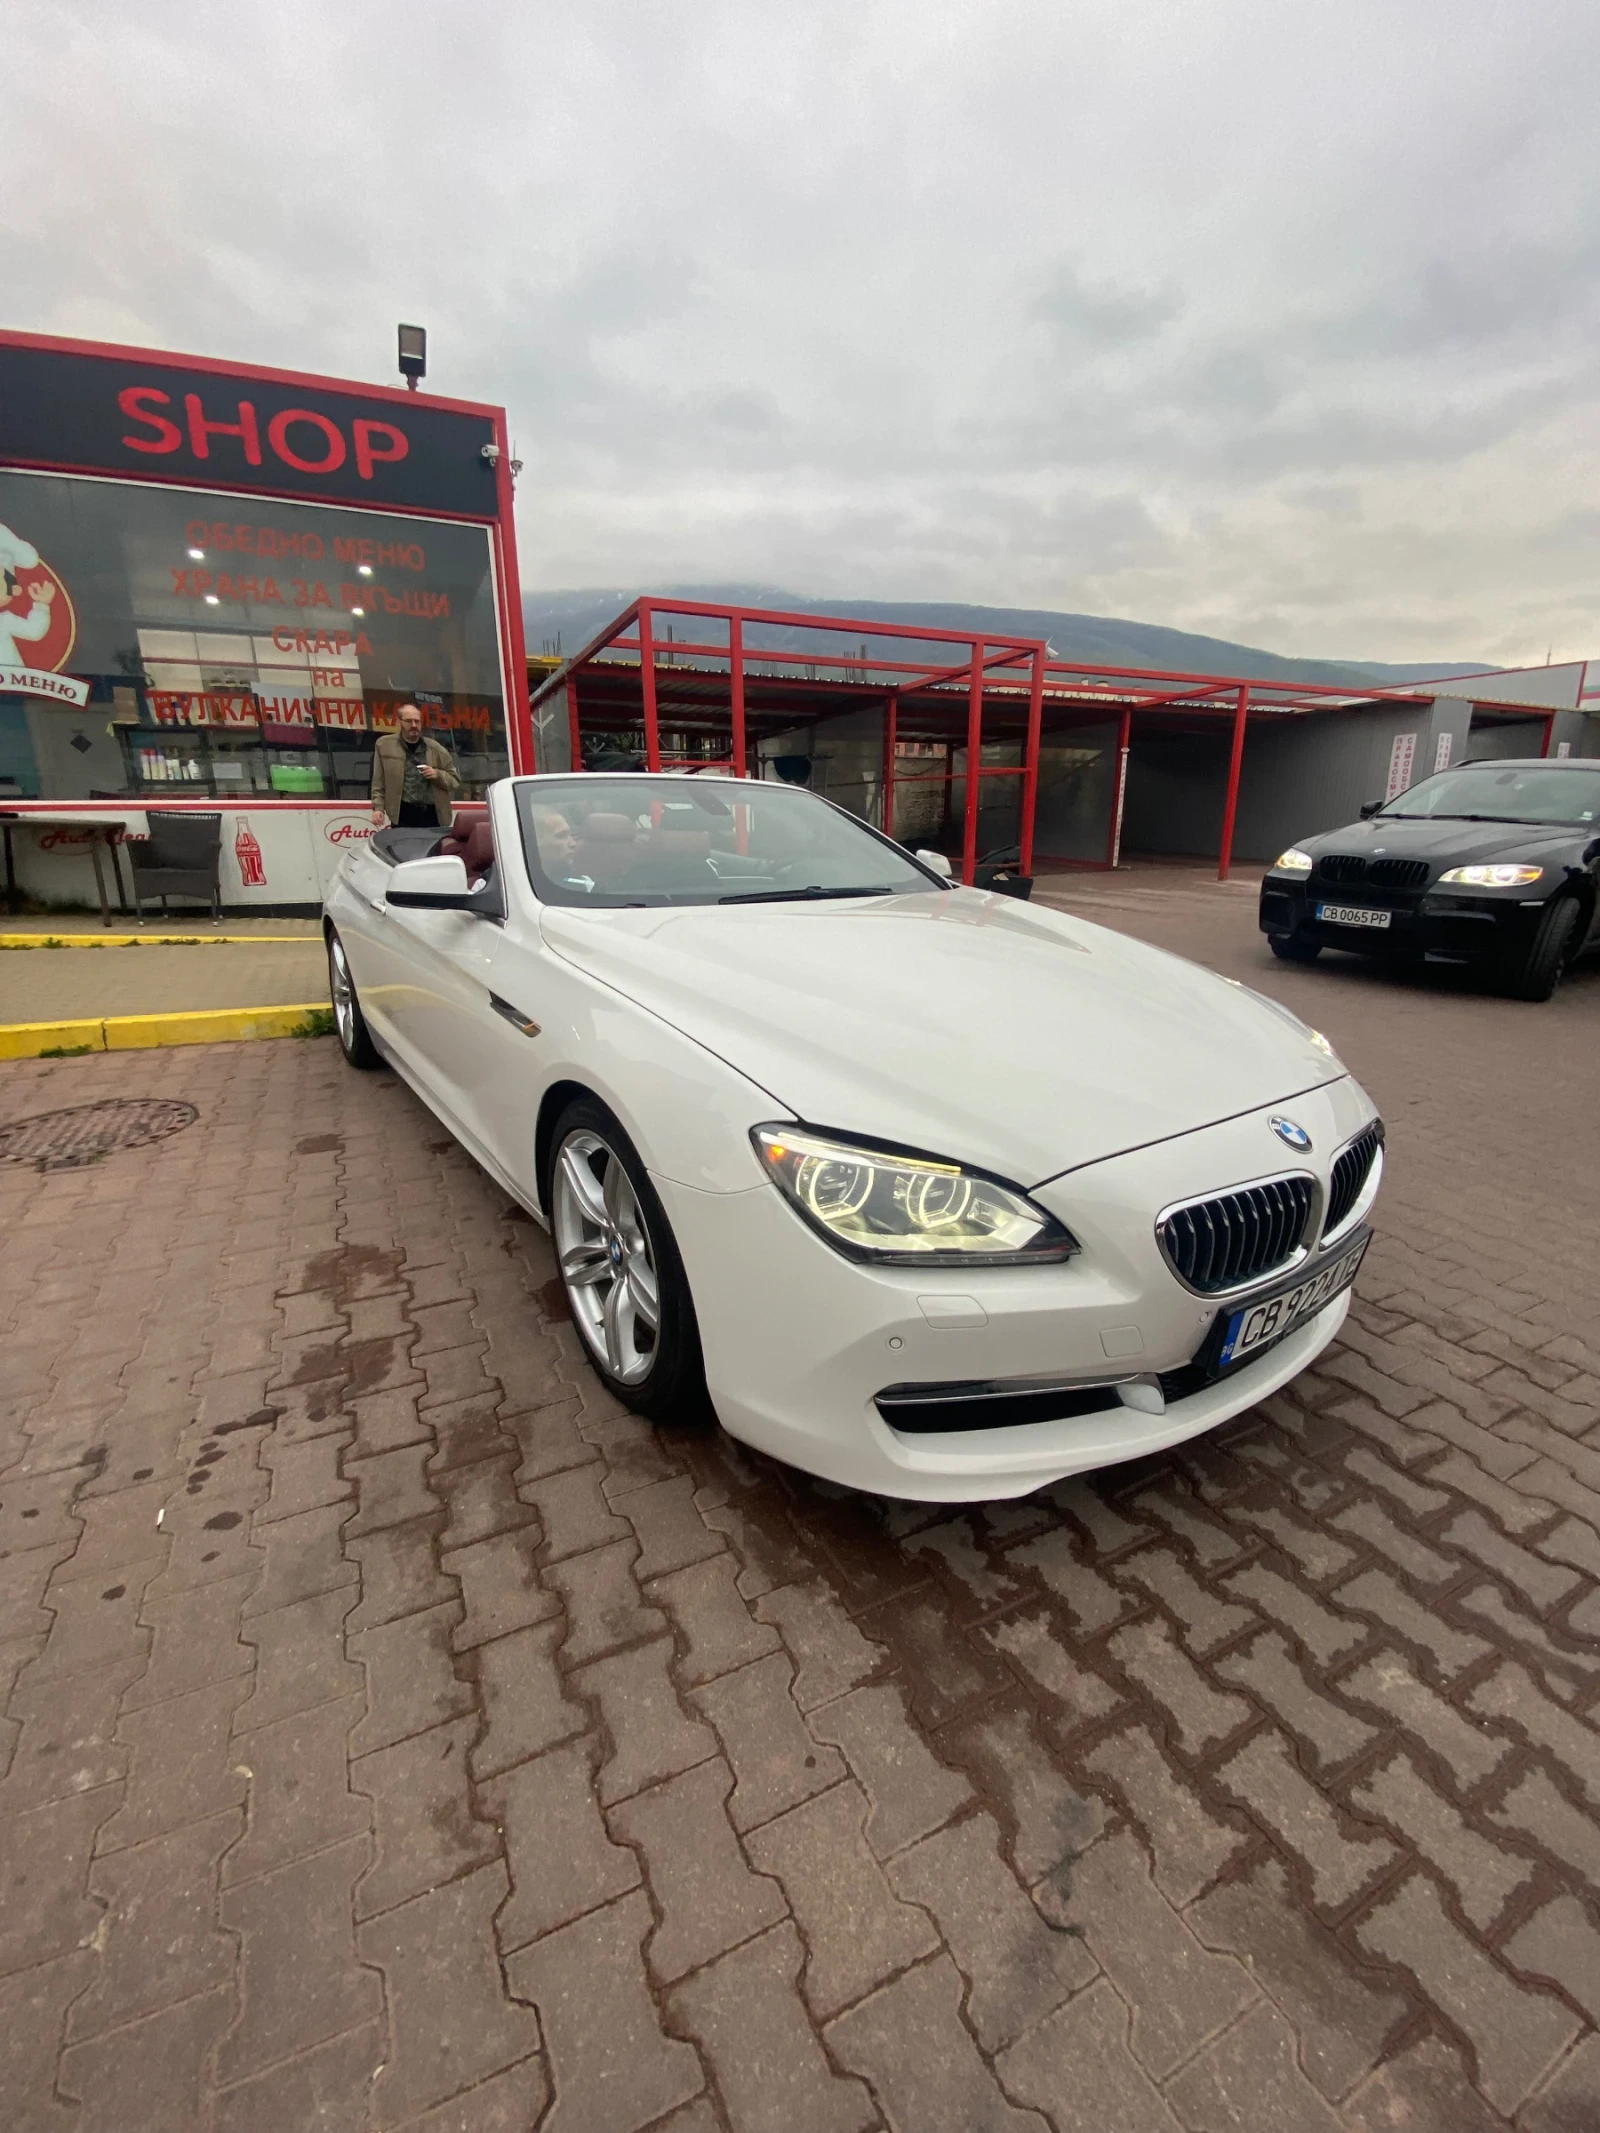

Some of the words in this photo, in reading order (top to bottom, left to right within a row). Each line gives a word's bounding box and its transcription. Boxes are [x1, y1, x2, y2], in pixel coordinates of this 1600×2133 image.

[118, 387, 409, 480] SHOP
[186, 520, 324, 563] ОБЕДНО
[333, 535, 426, 572] МЕНЮ
[169, 567, 286, 606] ХРАНА
[291, 577, 333, 609] ЗА
[340, 583, 450, 620] ВКЪЩИ
[272, 625, 374, 657] СКАРА
[10, 673, 77, 699] МЕНЮ
[312, 667, 346, 688] на
[153, 691, 365, 726] ВУЛКАНИЧНИ
[1388, 737, 1403, 802] ПРАХОСМУ
[1400, 736, 1414, 795] САМООБС
[1323, 907, 1338, 920] CB
[1340, 909, 1368, 923] 0065
[1370, 912, 1388, 925] PP
[1241, 1299, 1283, 1348] CB
